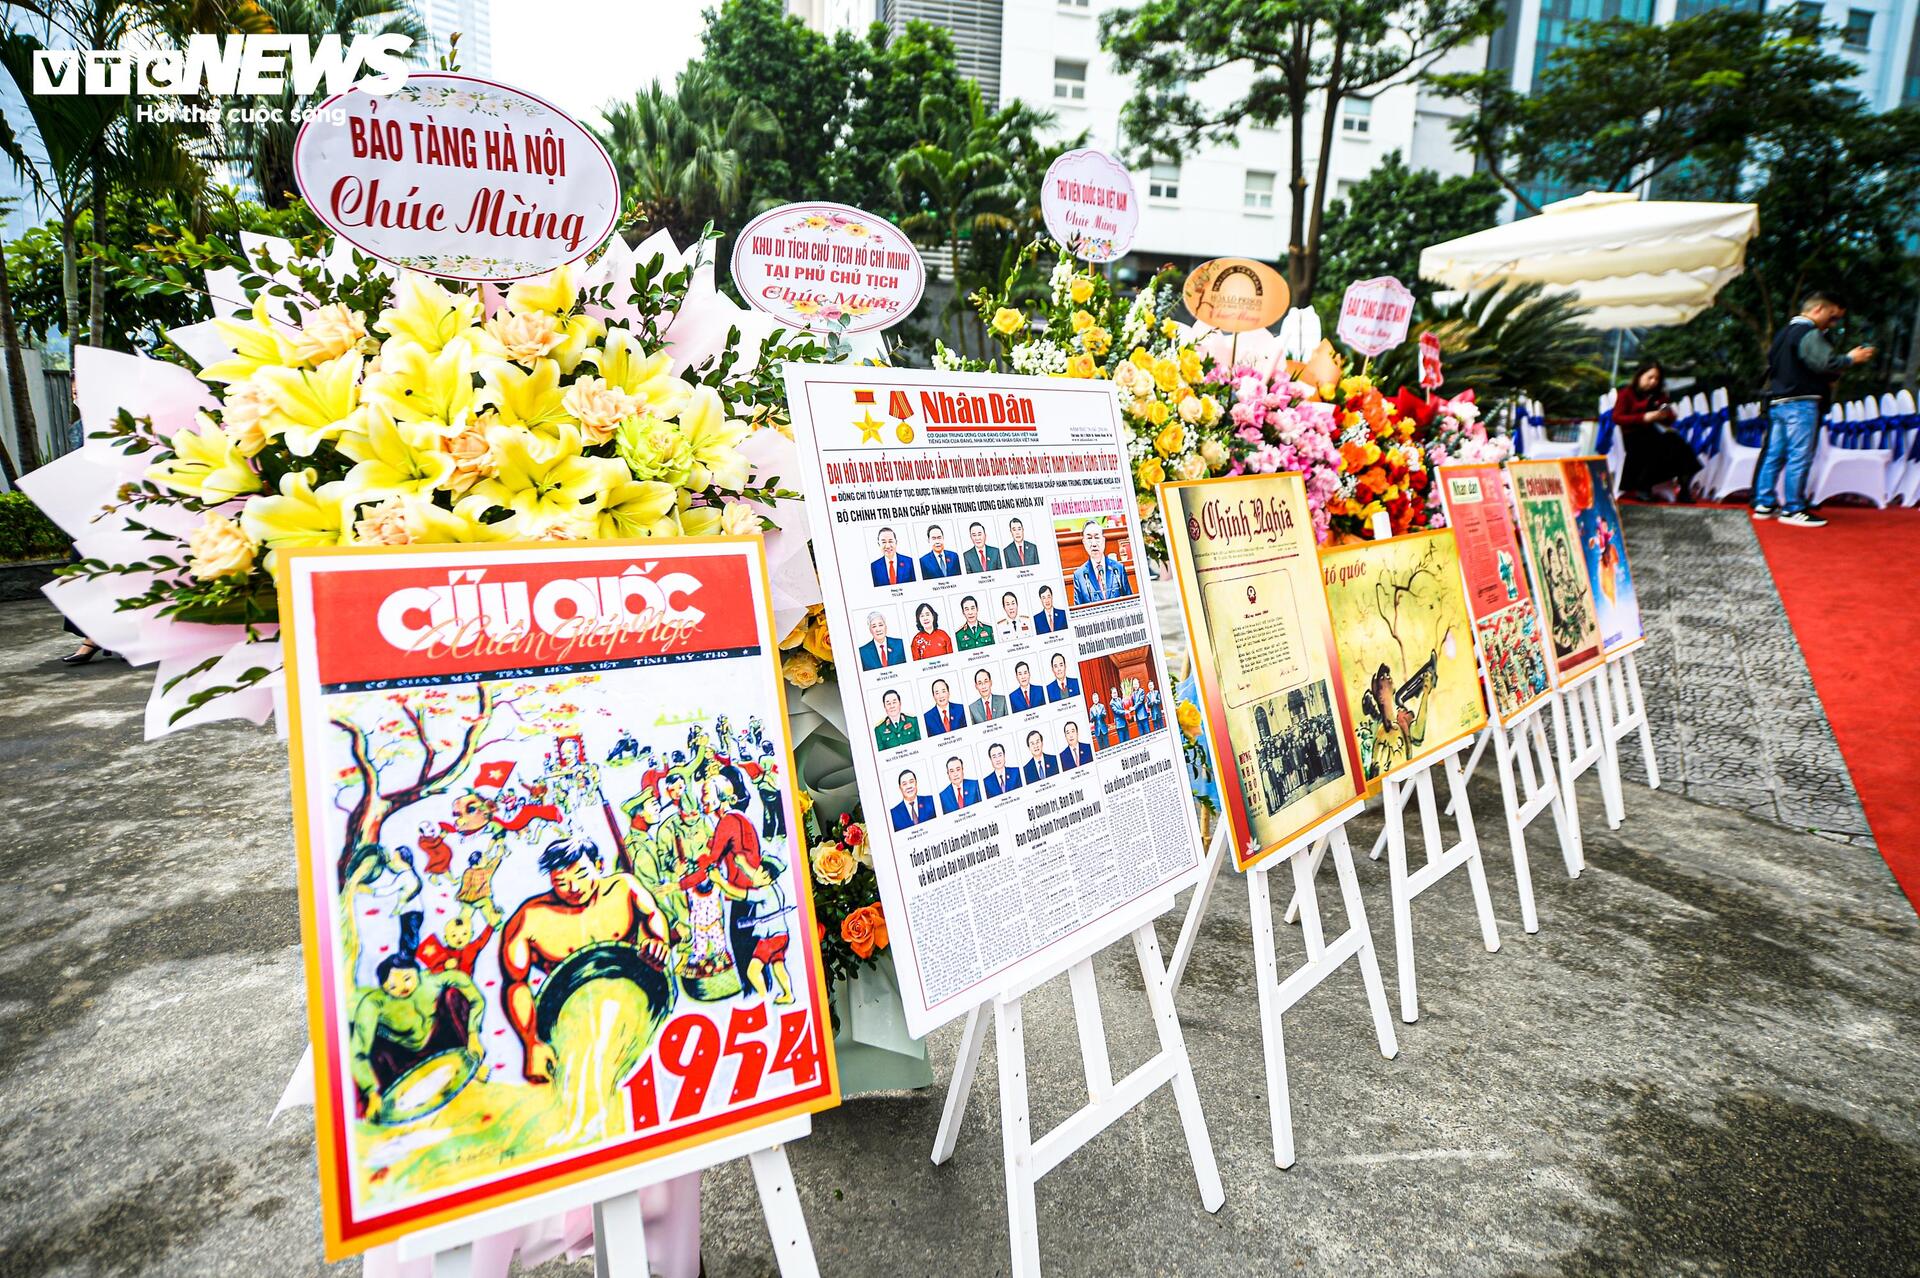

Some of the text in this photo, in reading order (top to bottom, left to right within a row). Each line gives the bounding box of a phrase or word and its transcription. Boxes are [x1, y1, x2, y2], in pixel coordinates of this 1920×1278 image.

[348, 100, 566, 185] BẢO TÀNG HÀ NỘI
[330, 175, 588, 253] Chúc Mừng
[752, 236, 910, 271] KHU DI TÍCH CHỦ TỊCH HỒ CHÍ MINH
[764, 263, 899, 290] TẠI PHỦ CHỦ TỊCH
[762, 285, 901, 313] Chúc Mừng
[920, 391, 1036, 424] Nhân Dân
[836, 495, 1044, 525] BỘ CHÍNH TRỊ BAN CHẤP HÀNH TRUNG ƯƠNG ĐẢNG KHÓA XIV
[1201, 499, 1253, 546] Chính
[1324, 560, 1367, 587] tổ quốc
[533, 561, 706, 638] QUỐC
[404, 605, 703, 662] Xuân Giáp Ngọ
[622, 1001, 821, 1132] 1954
